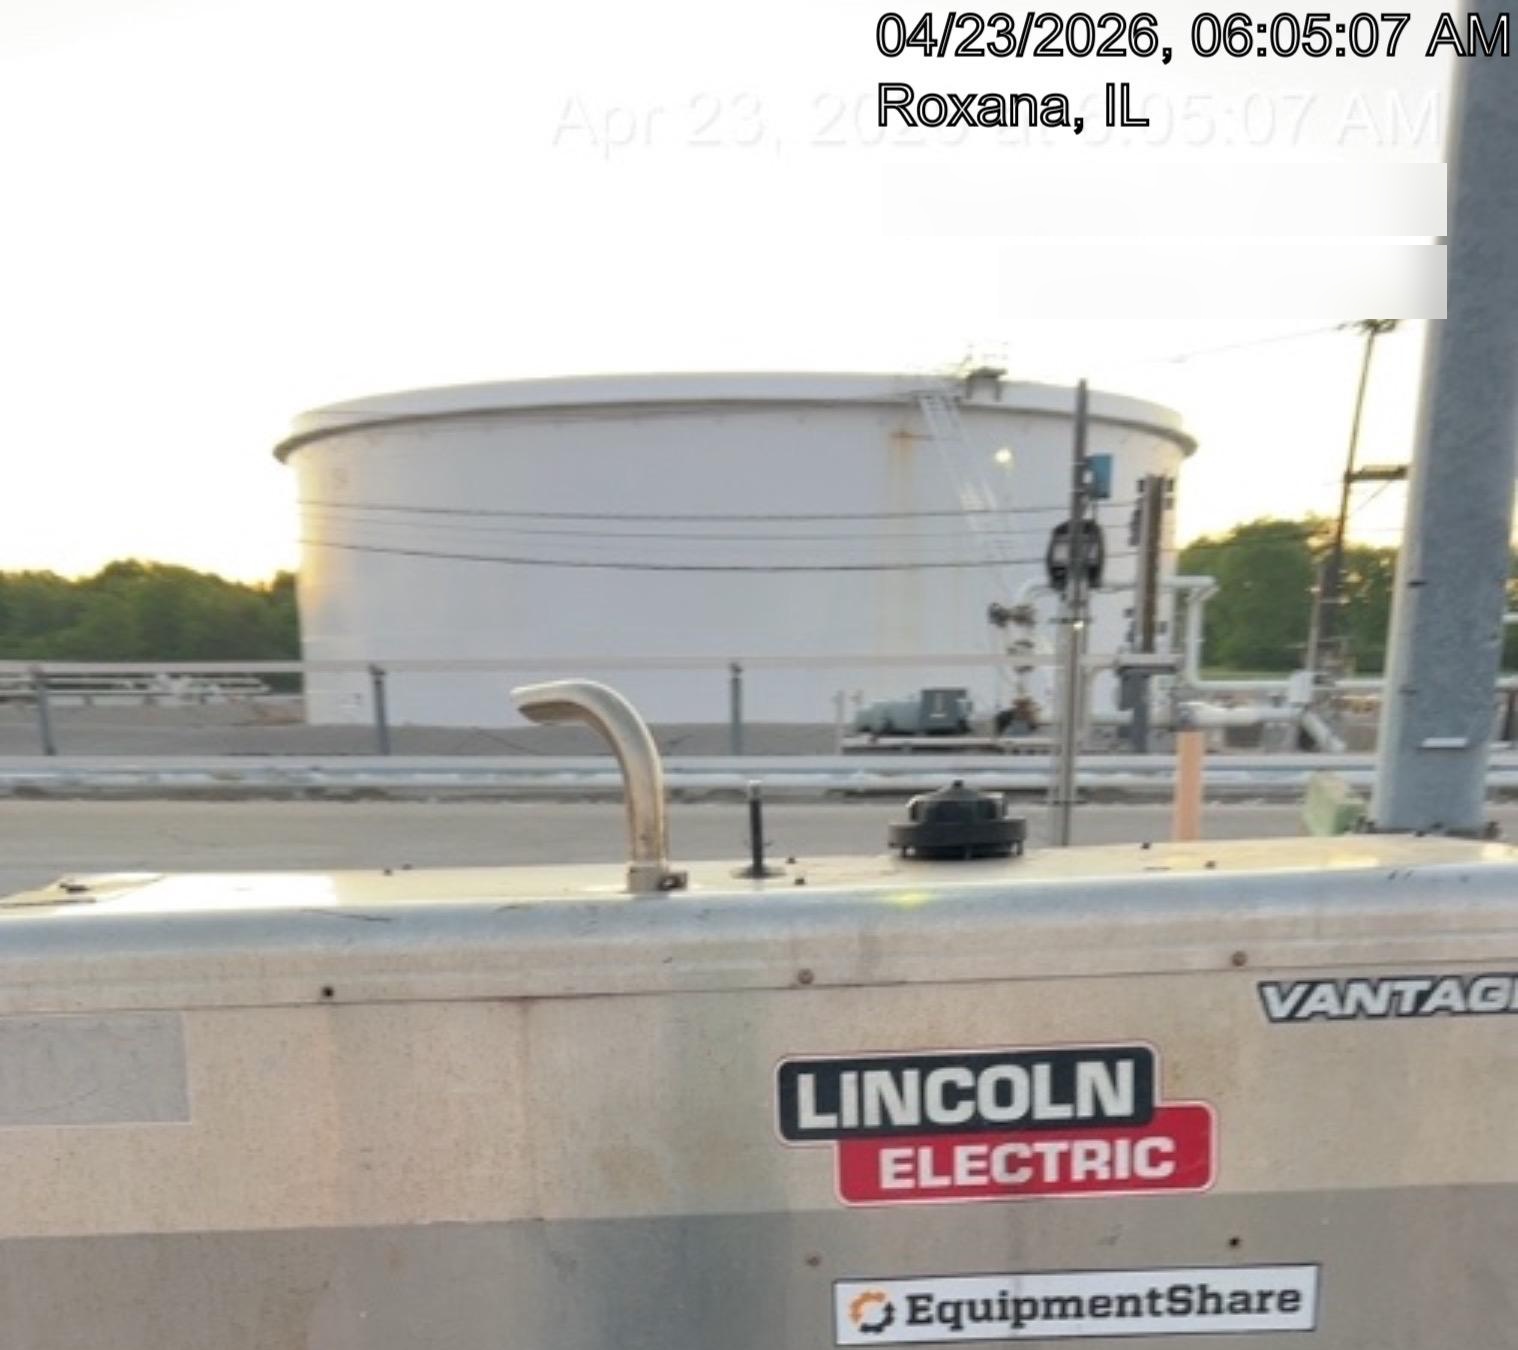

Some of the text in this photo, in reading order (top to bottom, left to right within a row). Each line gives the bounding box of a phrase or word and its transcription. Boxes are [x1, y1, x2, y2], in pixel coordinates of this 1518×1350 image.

[1260, 975, 1518, 1020] VANTAG
[798, 1058, 1135, 1129] LINCOLN
[878, 1136, 1176, 1190] ELECTRIC
[905, 1283, 1302, 1332] EquipmentShare
